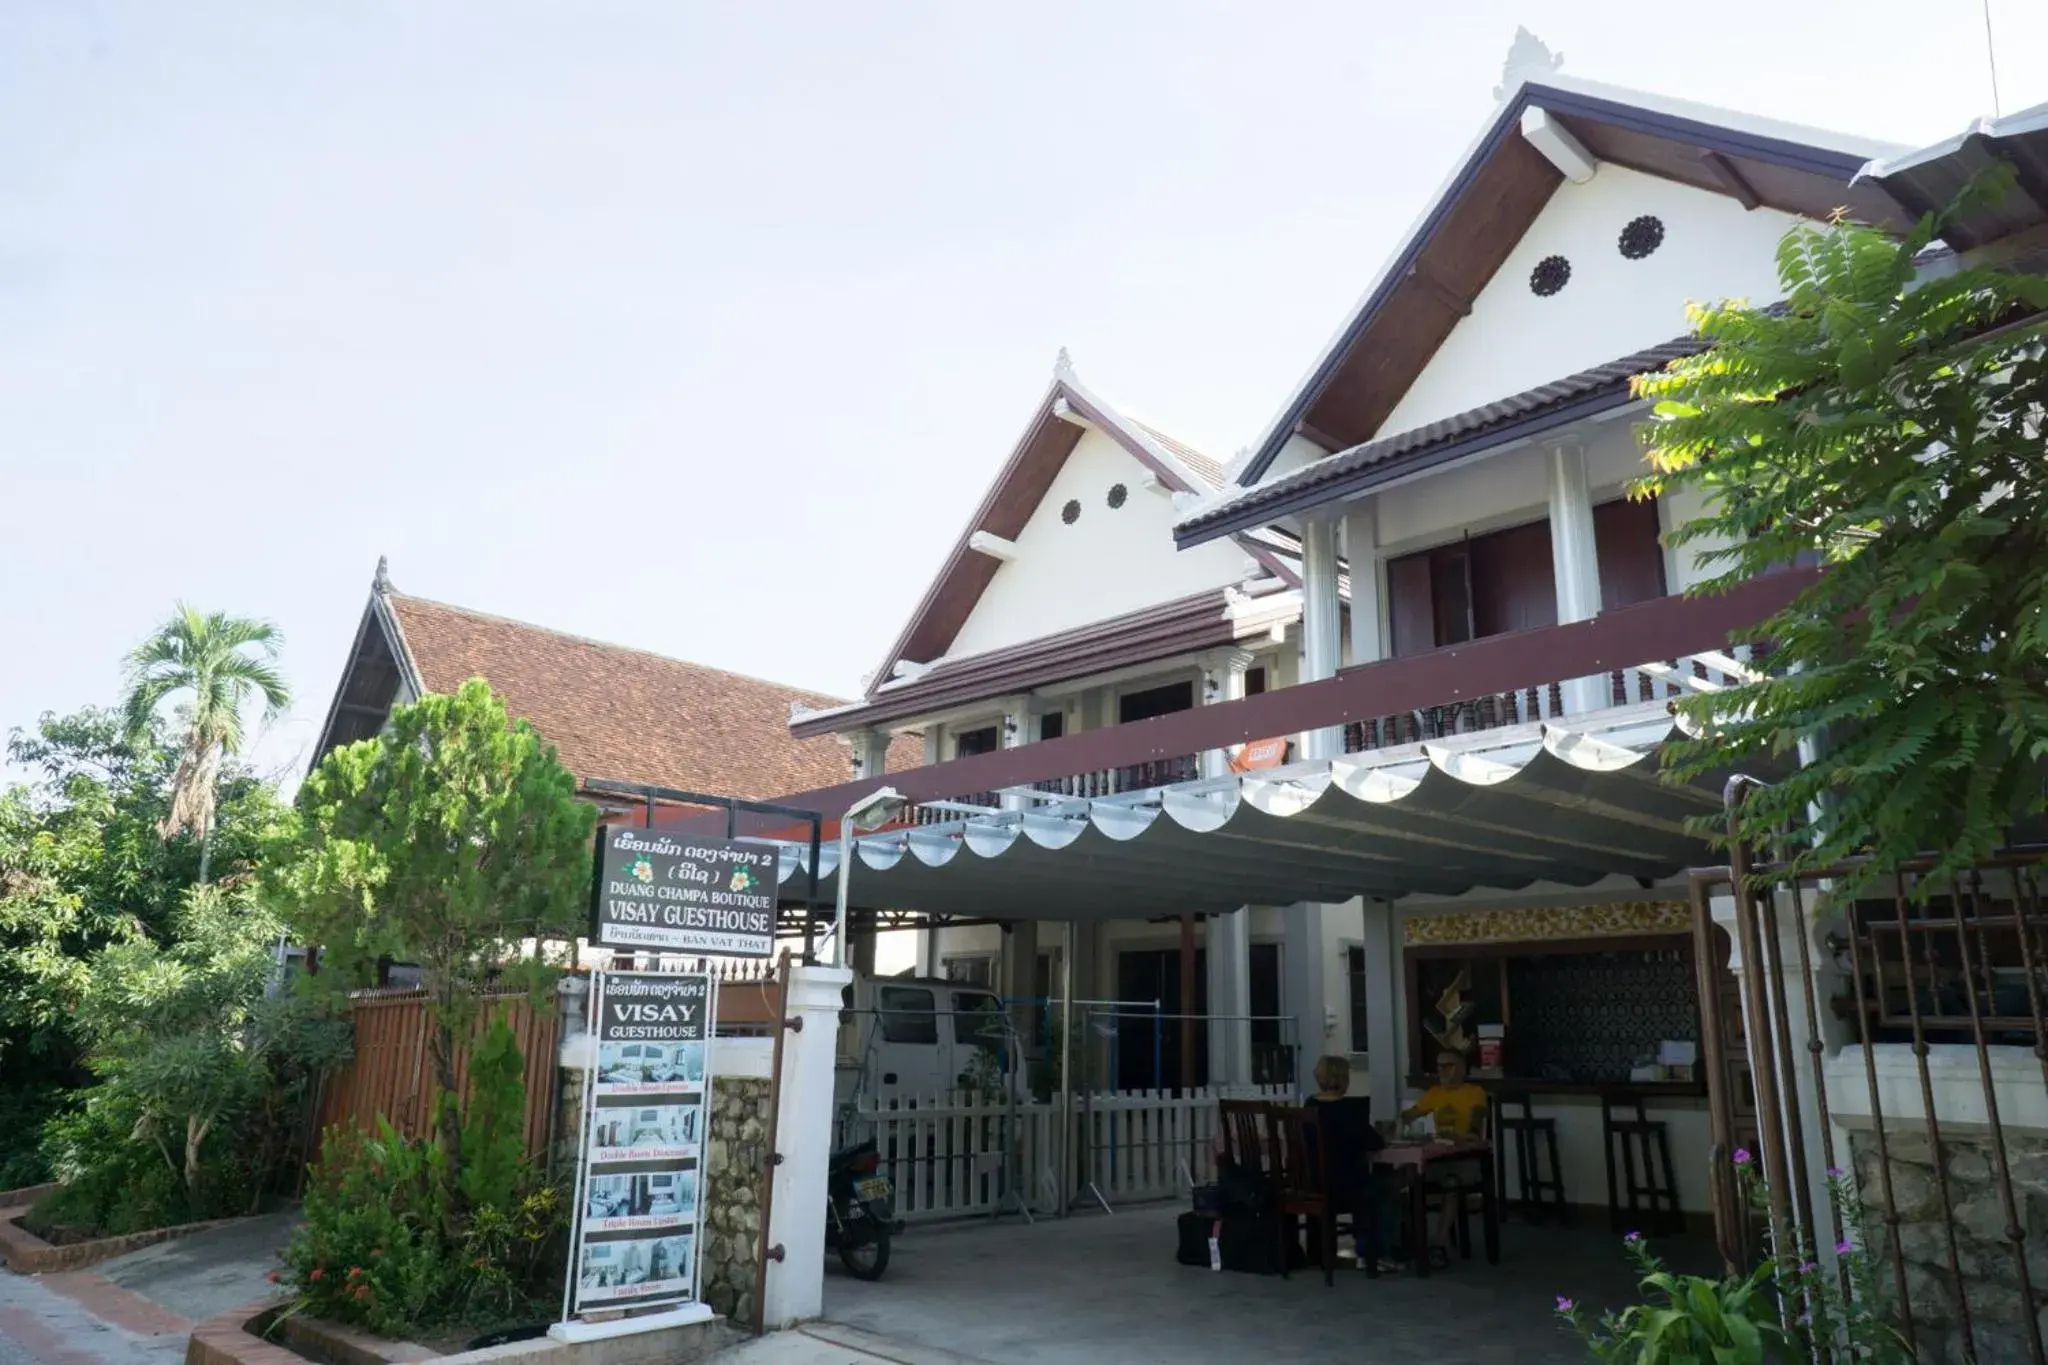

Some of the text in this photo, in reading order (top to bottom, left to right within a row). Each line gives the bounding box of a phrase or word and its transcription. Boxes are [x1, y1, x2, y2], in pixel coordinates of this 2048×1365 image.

[761, 854, 772, 867] 2
[609, 881, 770, 909] DUANG CHAMPA BOUTIQUE
[609, 900, 769, 932] VISAY GUESTHOUSE
[683, 935, 708, 945] BAN
[711, 937, 734, 947] VAT
[737, 939, 767, 949] THAT
[698, 985, 705, 997] 2
[613, 1004, 696, 1022] VISAY
[609, 1025, 697, 1038] GUESTHOUSE
